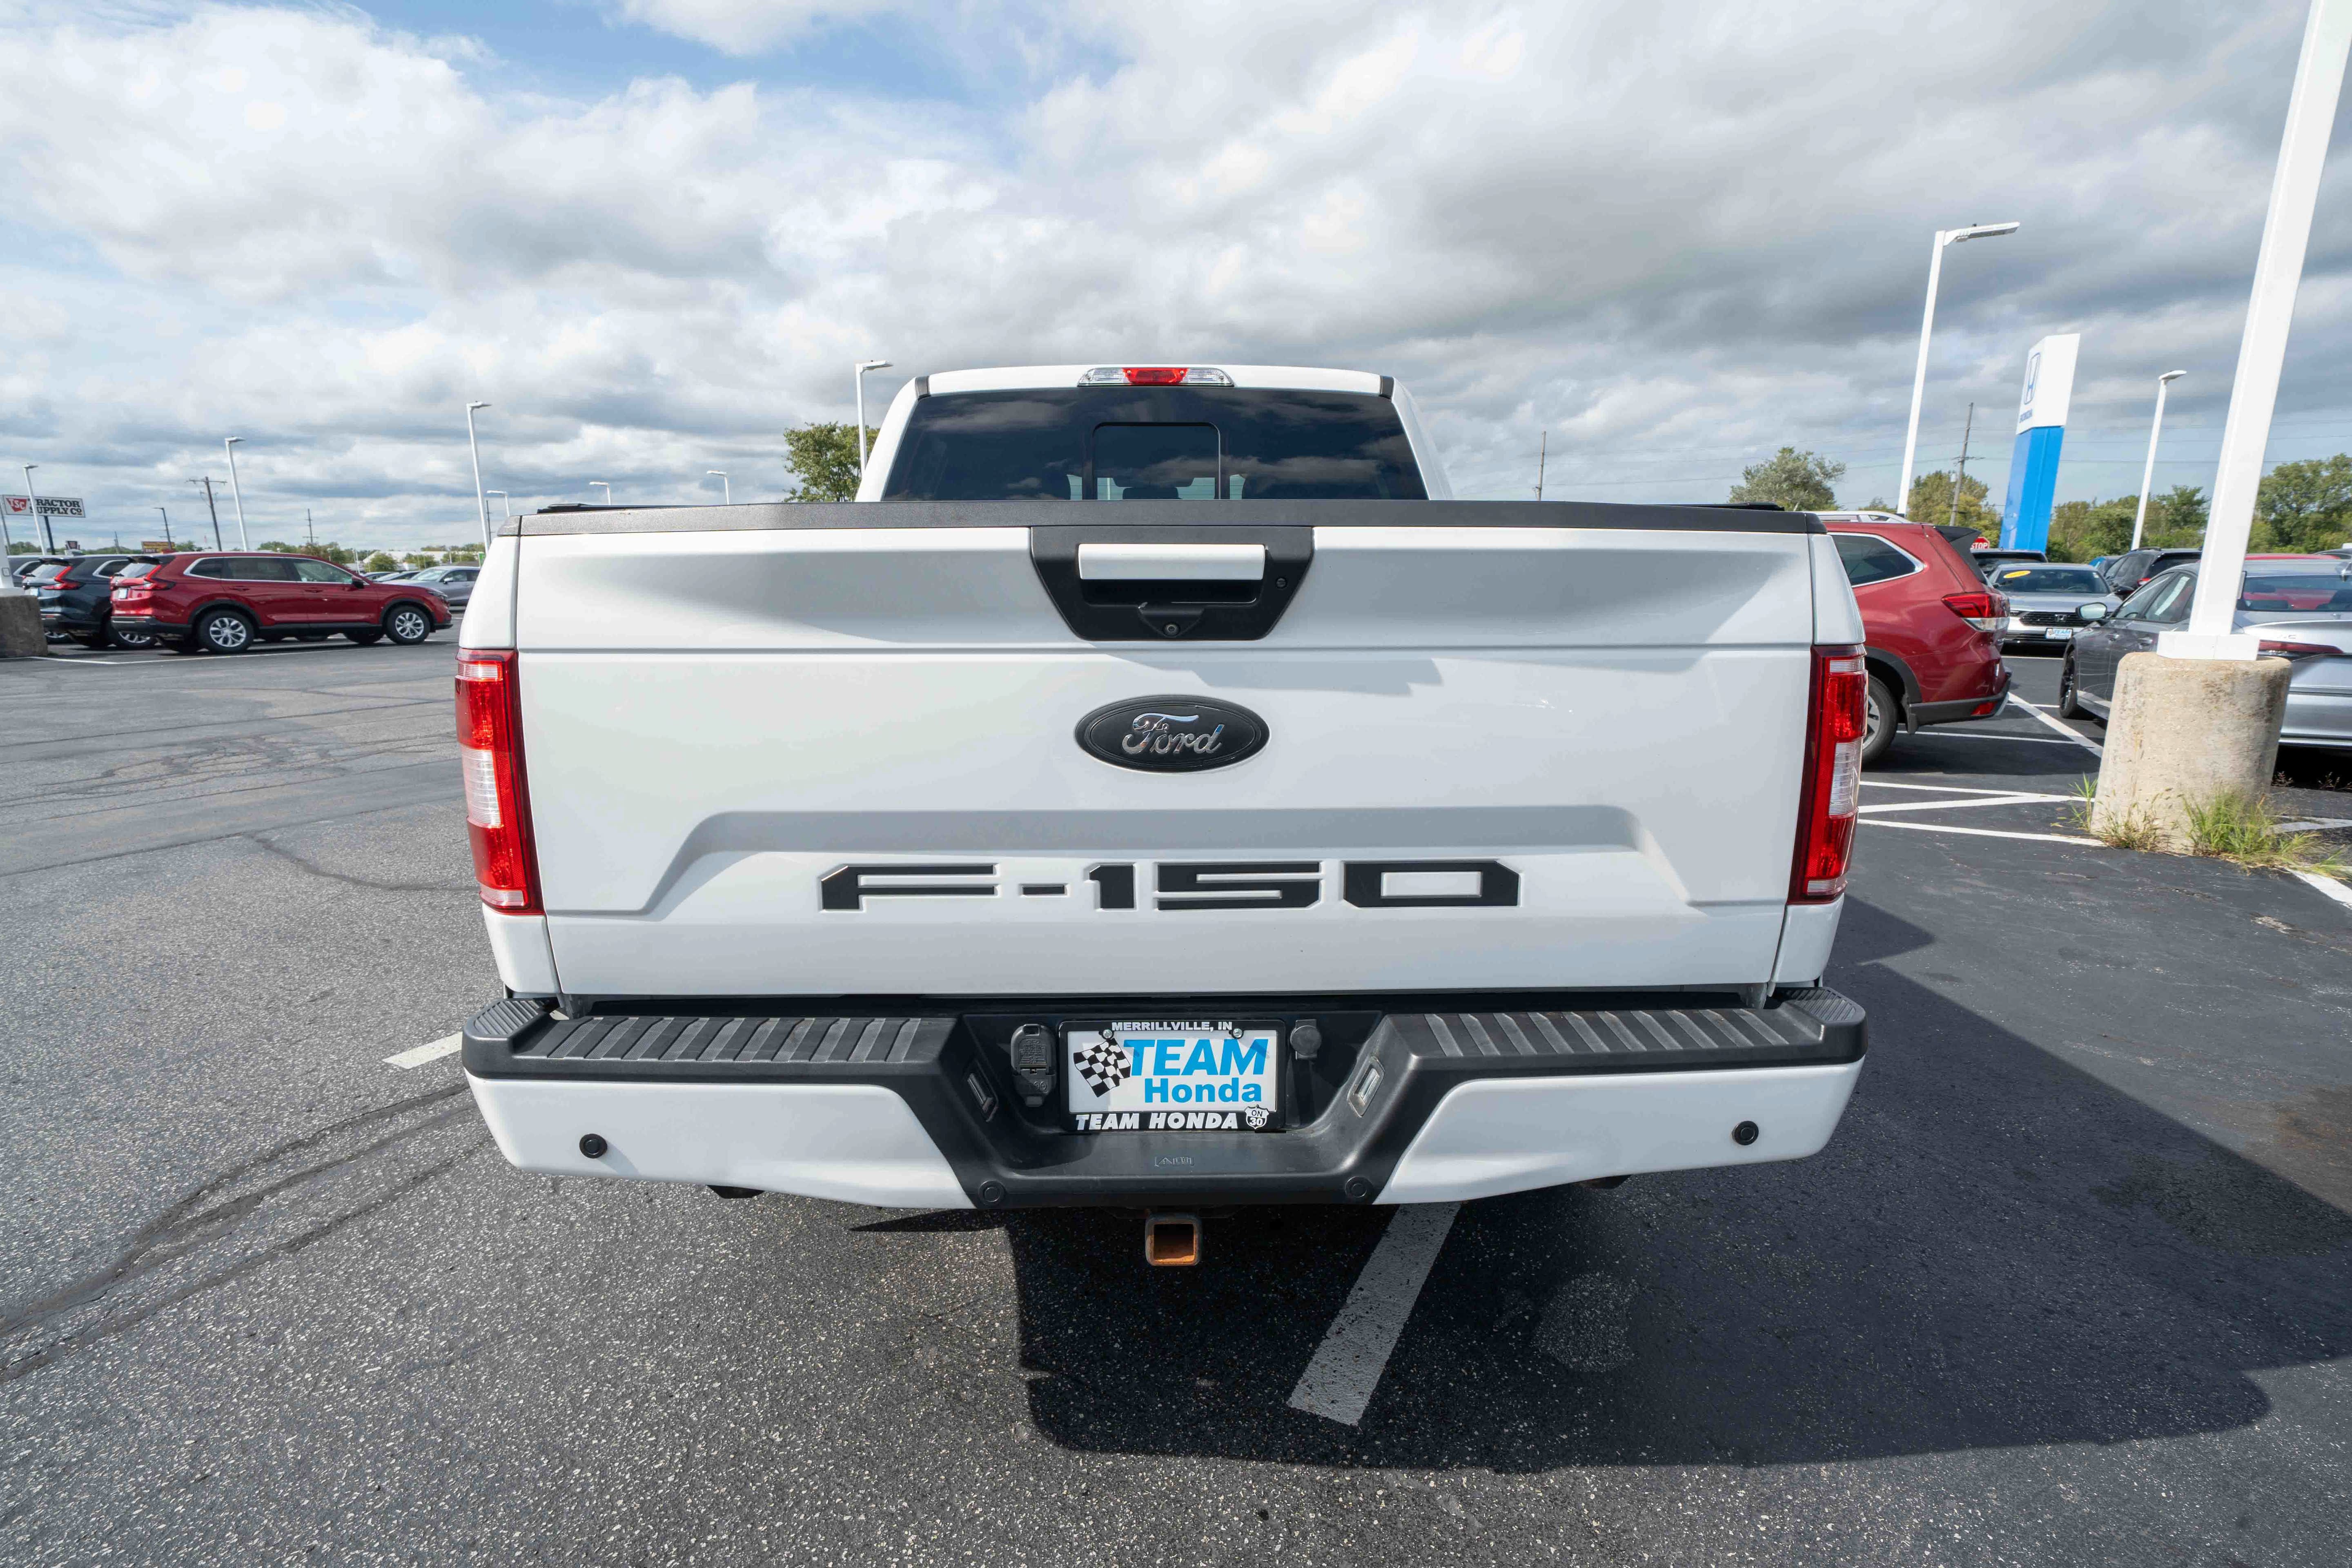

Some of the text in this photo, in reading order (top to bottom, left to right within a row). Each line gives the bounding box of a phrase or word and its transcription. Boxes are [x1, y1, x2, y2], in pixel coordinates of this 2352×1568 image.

[1122, 712, 1225, 755] Ford
[820, 862, 1521, 911] F-150
[1112, 1022, 1232, 1032] MERRILLVILLE, IN
[1123, 1039, 1269, 1076] TEAM
[1144, 1077, 1262, 1103] Honda
[1076, 1112, 1238, 1131] TEAM HONDA
[1250, 1117, 1263, 1126] 30
